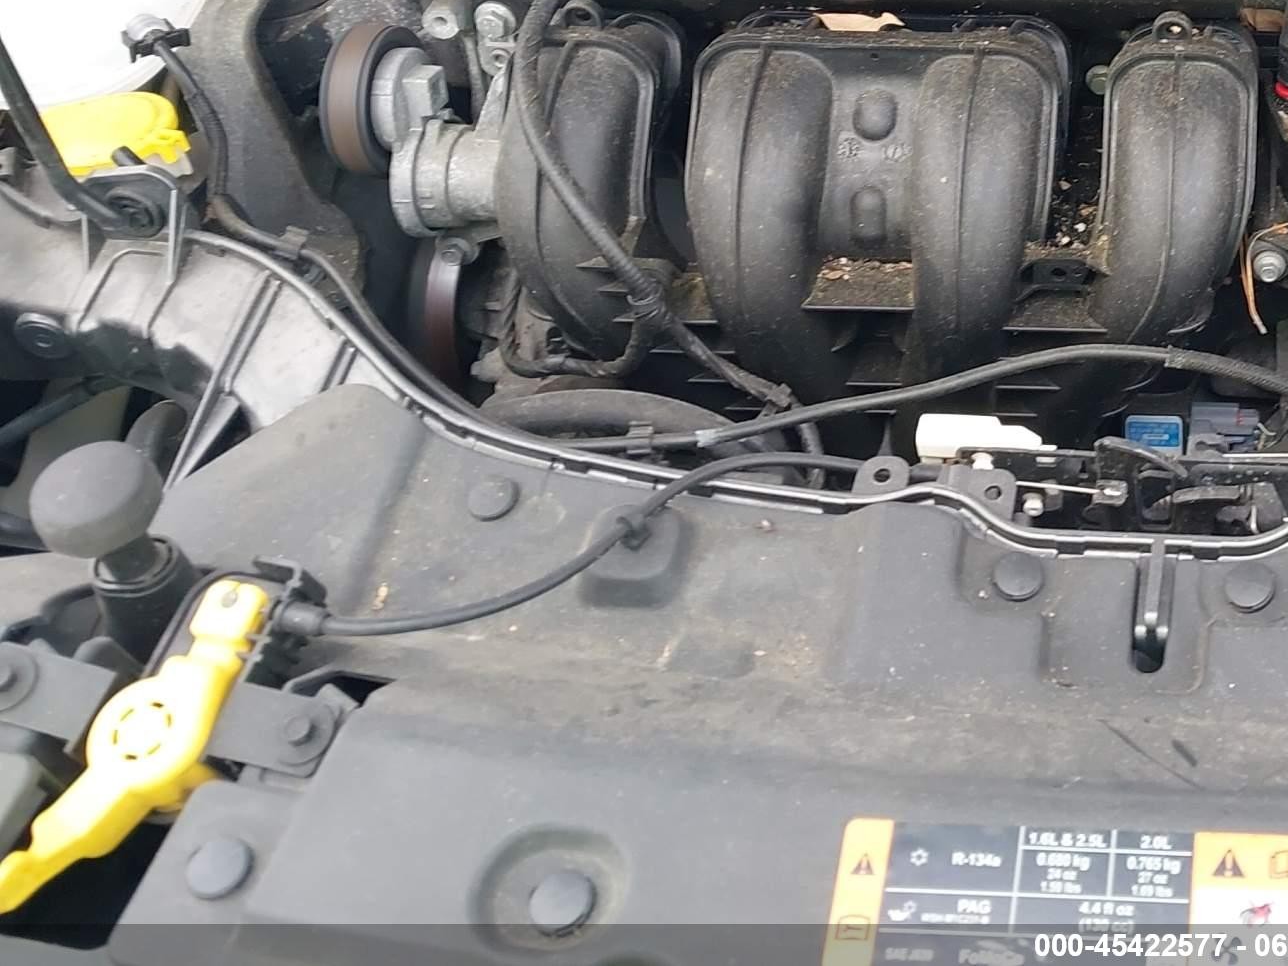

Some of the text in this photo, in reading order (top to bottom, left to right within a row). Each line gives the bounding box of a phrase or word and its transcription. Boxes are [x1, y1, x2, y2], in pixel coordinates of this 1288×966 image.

[1028, 832, 1058, 846] 1.6L
[1075, 833, 1108, 848] 2.5L
[1139, 835, 1172, 850] 2.0L
[951, 851, 1002, 868] R-134a
[1163, 857, 1182, 875] kg
[956, 899, 992, 914] PAG
